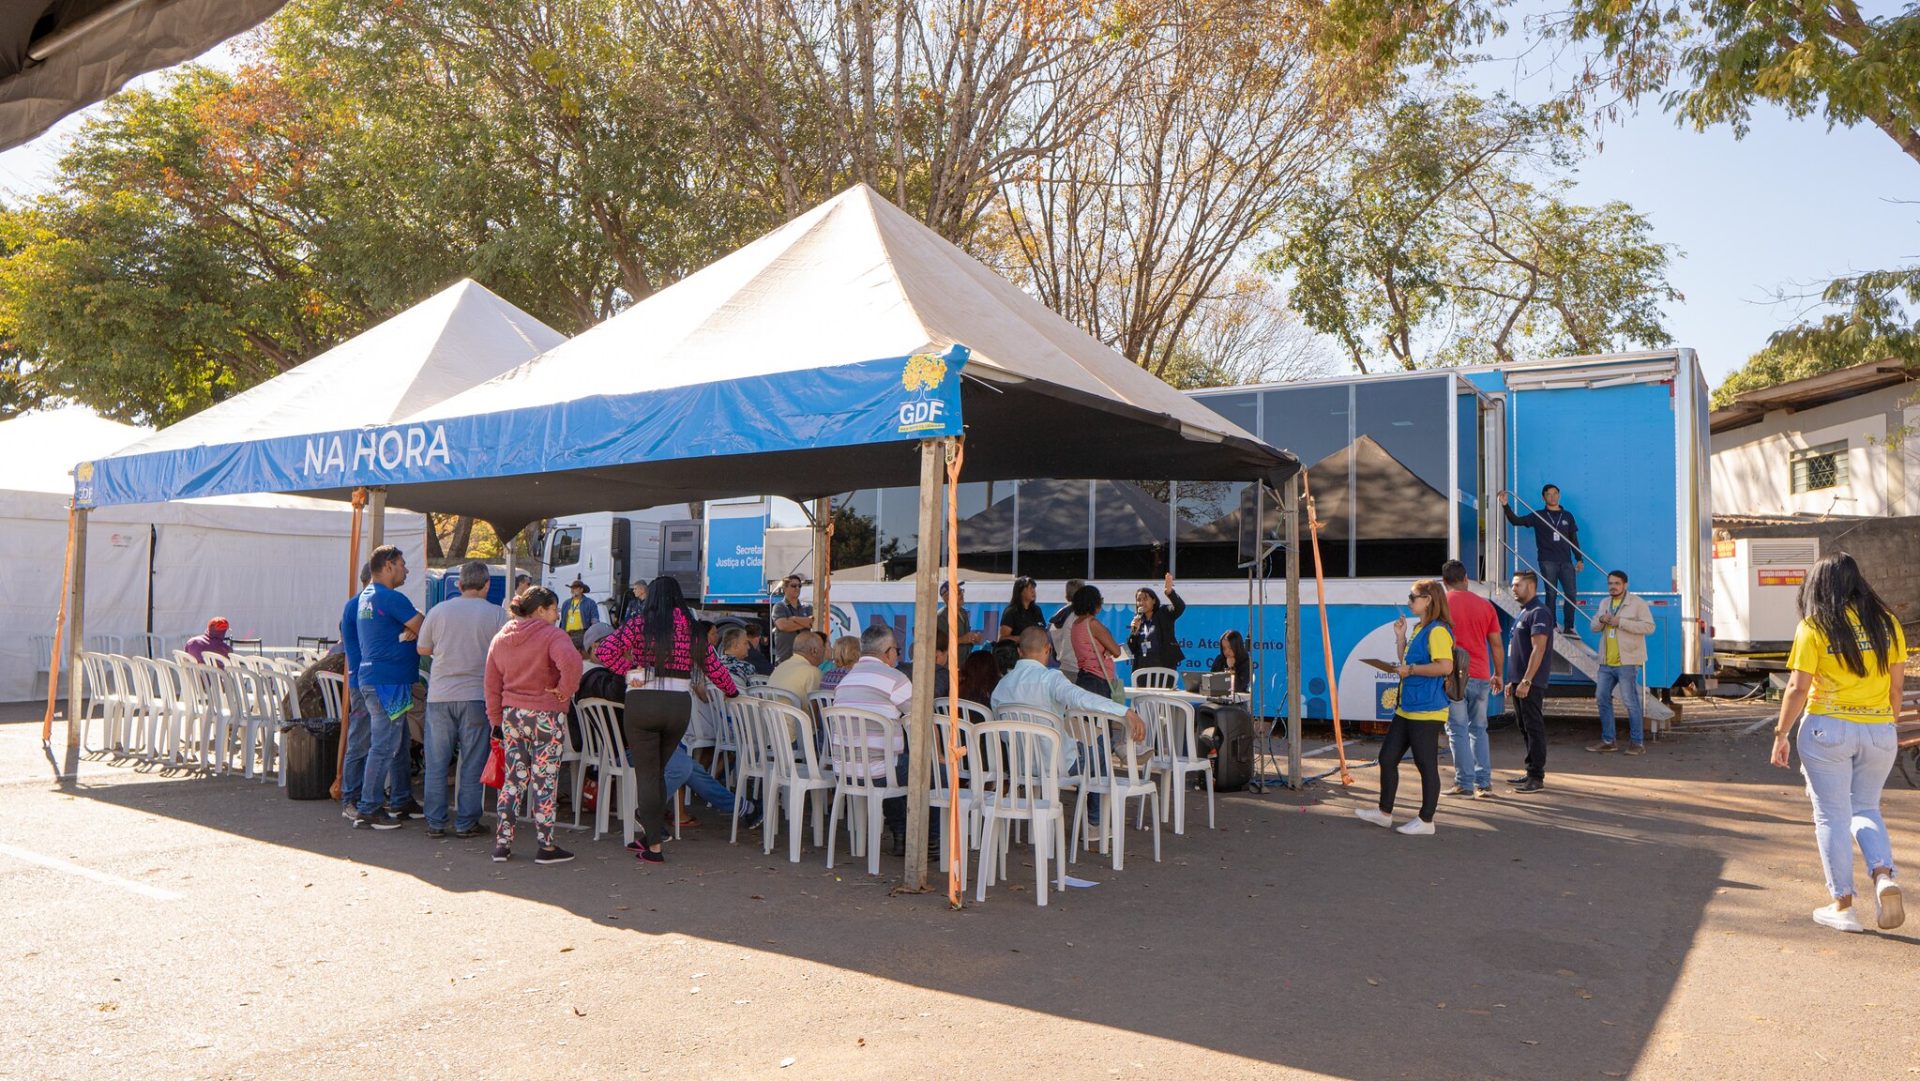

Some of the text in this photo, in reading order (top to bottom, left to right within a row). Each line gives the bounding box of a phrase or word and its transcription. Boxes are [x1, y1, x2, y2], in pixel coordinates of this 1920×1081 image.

[900, 401, 944, 424] GDF
[303, 424, 451, 476] NA HORA
[716, 556, 739, 568] Justiça
[1179, 637, 1284, 650] de Ateento
[1186, 659, 1201, 668] ao
